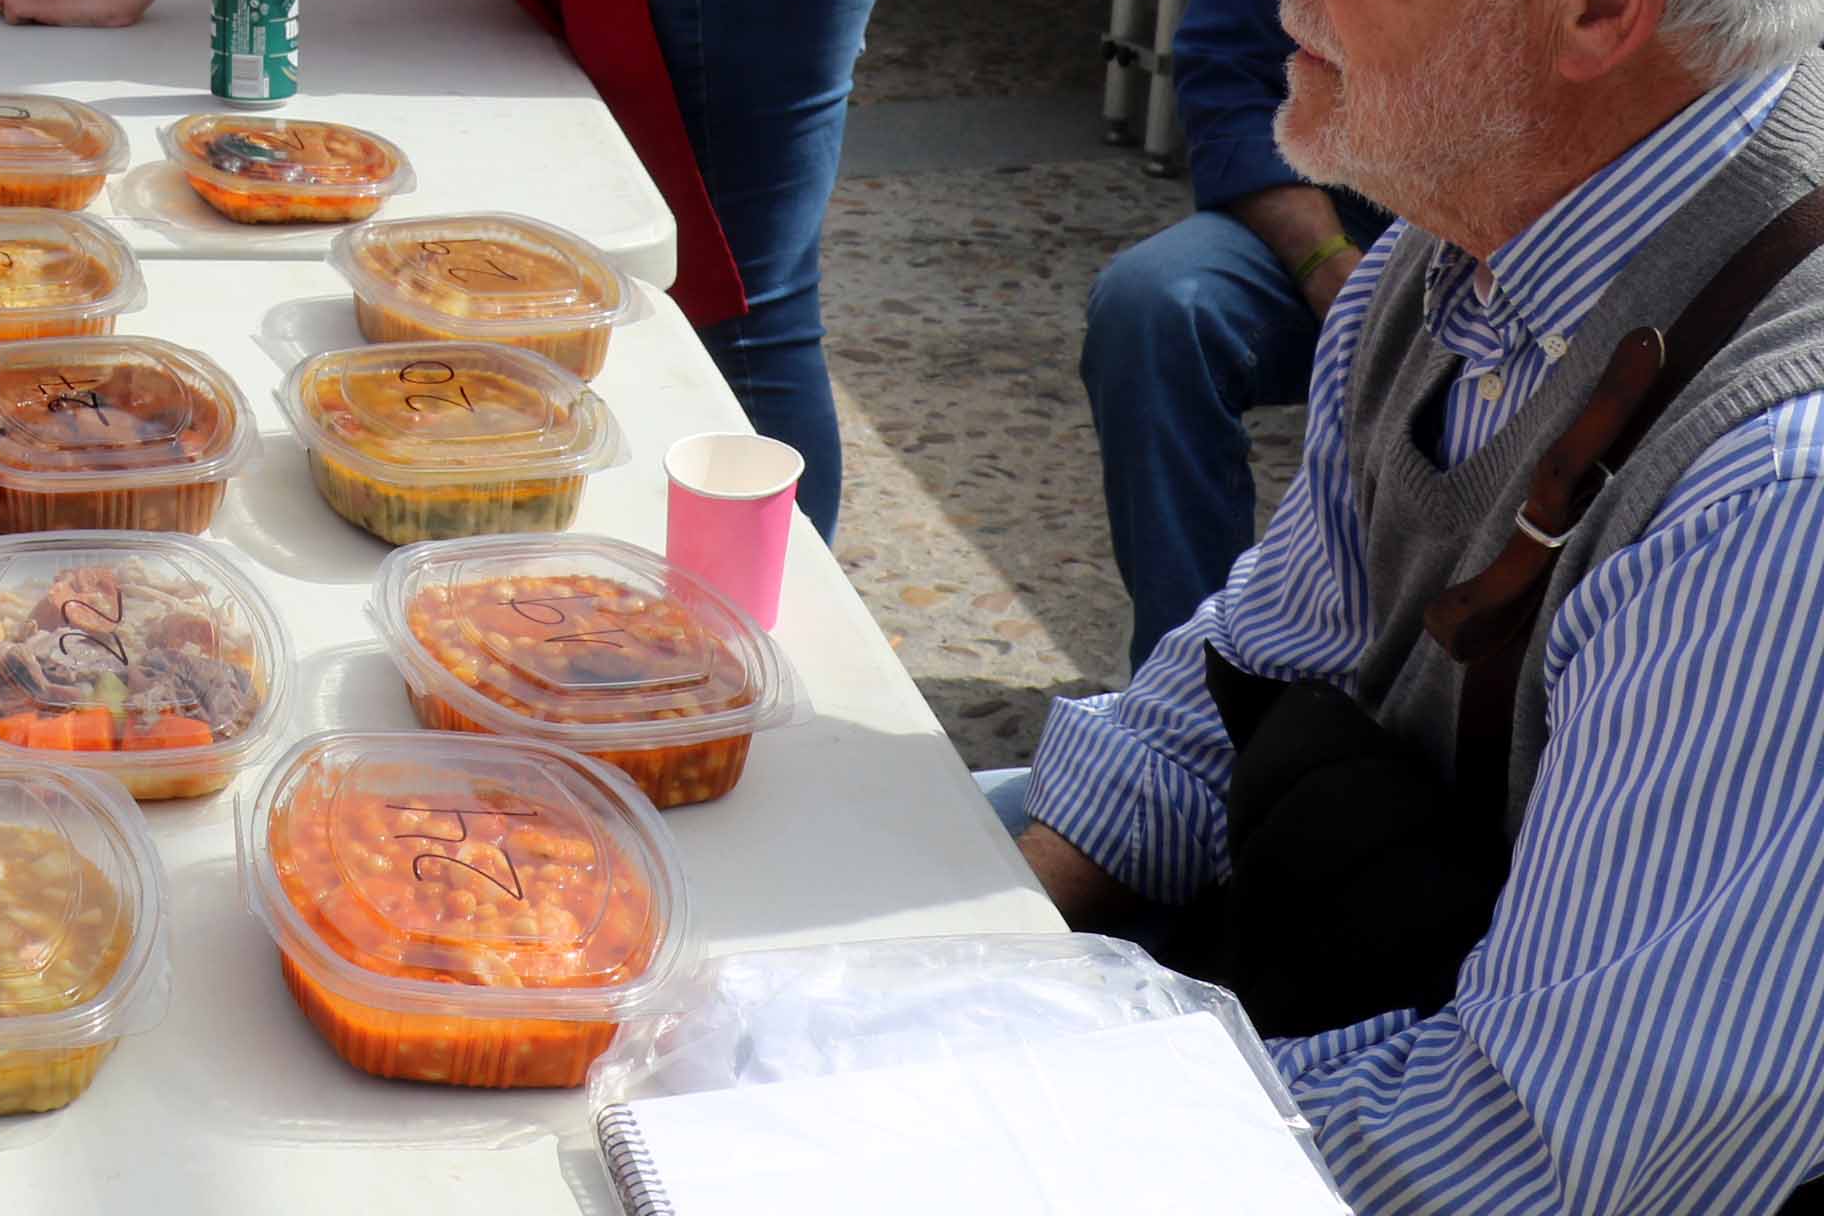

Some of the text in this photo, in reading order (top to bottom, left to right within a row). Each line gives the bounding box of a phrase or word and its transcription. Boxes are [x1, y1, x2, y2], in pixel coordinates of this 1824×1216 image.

[416, 238, 518, 282] 29
[399, 360, 476, 414] 20
[59, 590, 128, 666] 22
[498, 592, 624, 649] 19
[385, 802, 538, 901] 24
